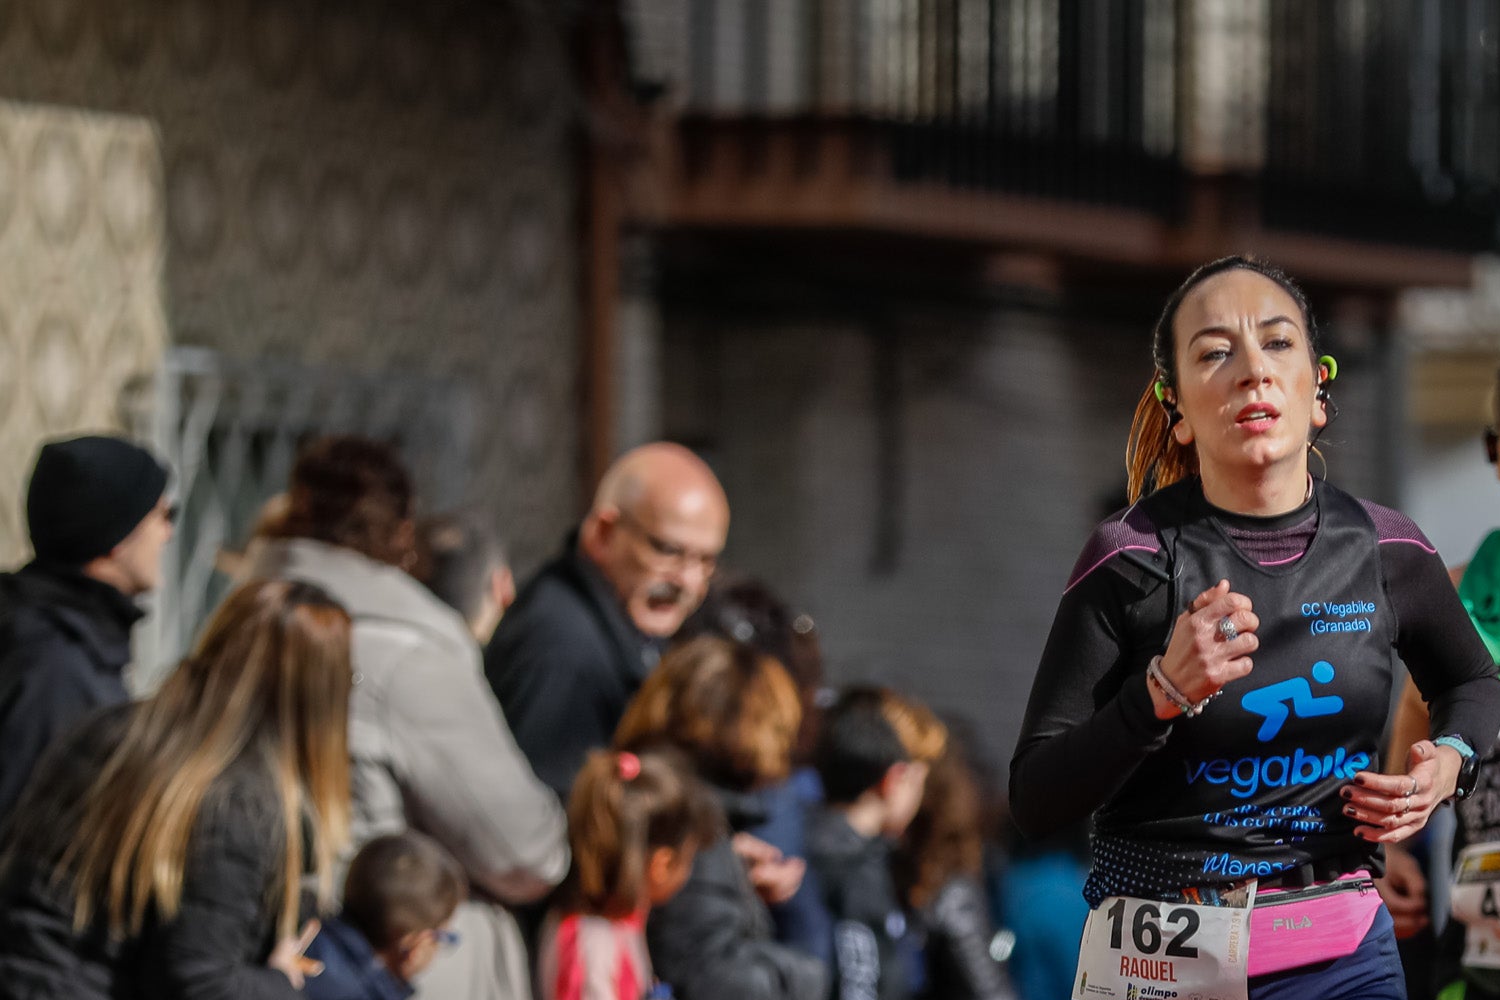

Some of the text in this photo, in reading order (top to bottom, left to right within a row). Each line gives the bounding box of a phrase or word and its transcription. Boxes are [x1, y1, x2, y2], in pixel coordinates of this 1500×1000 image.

[1301, 601, 1375, 618] CC Vegabike
[1311, 617, 1371, 635] (Granada)
[1107, 898, 1200, 958] 162
[1272, 916, 1313, 932] FILA
[1119, 955, 1178, 982] RAQUEL
[1140, 985, 1178, 999] olimpo
